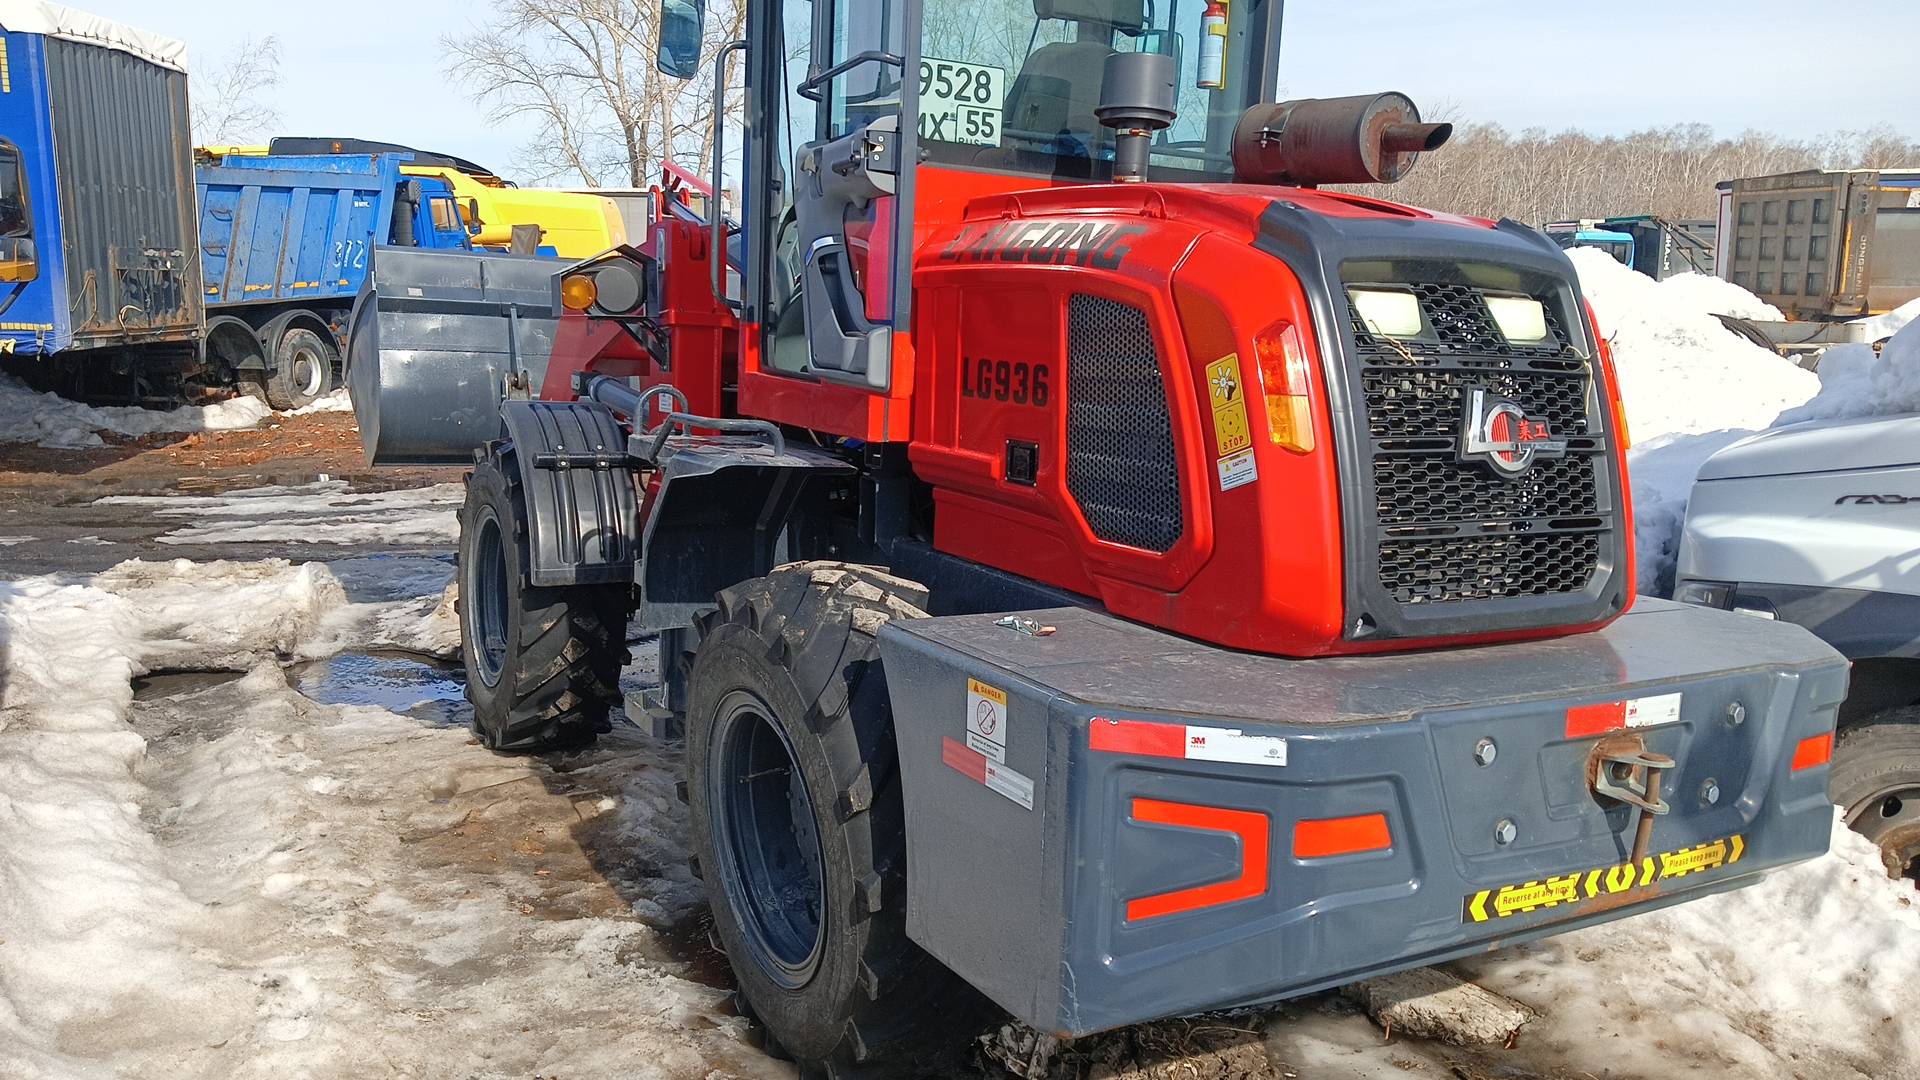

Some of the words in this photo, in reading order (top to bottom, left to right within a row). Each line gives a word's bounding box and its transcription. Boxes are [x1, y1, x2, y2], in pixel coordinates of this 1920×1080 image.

[919, 61, 991, 104] 9528
[966, 110, 994, 138] 55
[962, 357, 1049, 407] LG936
[1223, 435, 1244, 450] STOP
[1190, 736, 1206, 745] 3M
[1669, 857, 1689, 868] Please
[1502, 892, 1532, 905] Reverse
